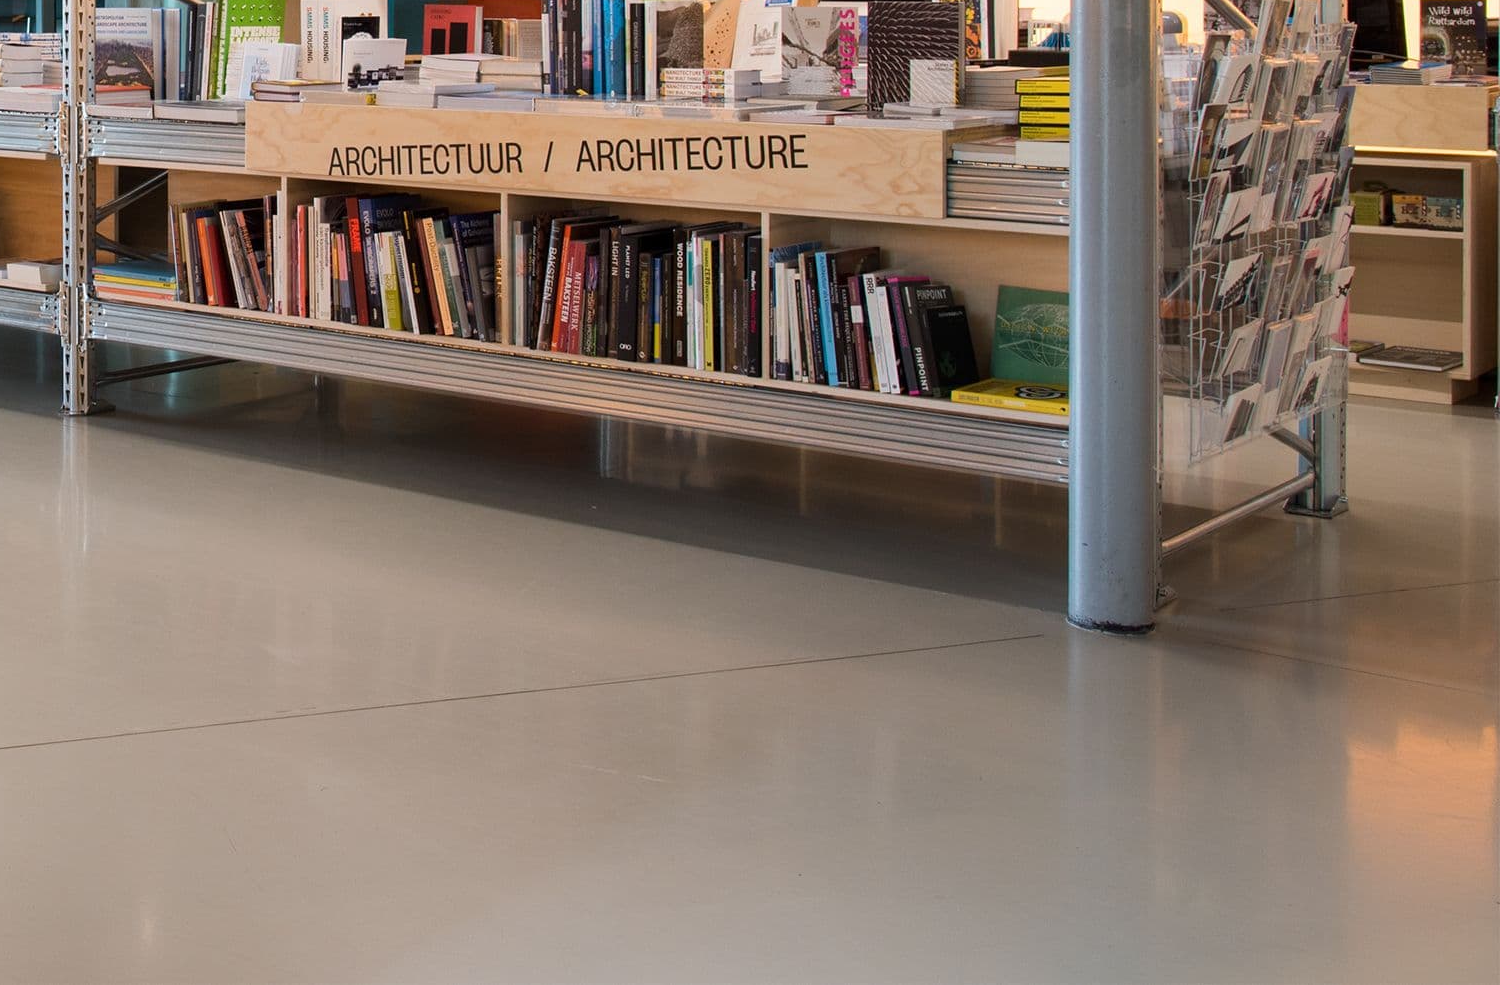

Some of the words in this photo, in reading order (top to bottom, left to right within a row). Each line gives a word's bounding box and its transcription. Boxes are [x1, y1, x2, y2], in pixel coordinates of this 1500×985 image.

[1427, 5, 1451, 17] Wild
[1452, 5, 1473, 17] wild
[1427, 16, 1476, 26] Rotterdam
[328, 143, 523, 176] ARCHITECTUUR
[543, 140, 554, 173] /
[576, 135, 809, 172] ARCHITECTURE
[350, 218, 362, 253] FRAME
[362, 210, 372, 235] EVOLO
[426, 222, 441, 272] Post-Ductility
[611, 241, 619, 265] LIGHT
[676, 242, 684, 268] WOOD
[543, 246, 557, 302] BAKSTEEN
[611, 266, 619, 277] IN
[866, 277, 875, 294] RRR
[560, 276, 573, 323] BAKSTEEN
[570, 271, 582, 331] METSELWERK
[676, 270, 684, 317] RESIDENCE
[916, 289, 947, 300] PINPOINT
[914, 347, 929, 392] PINPOINT
